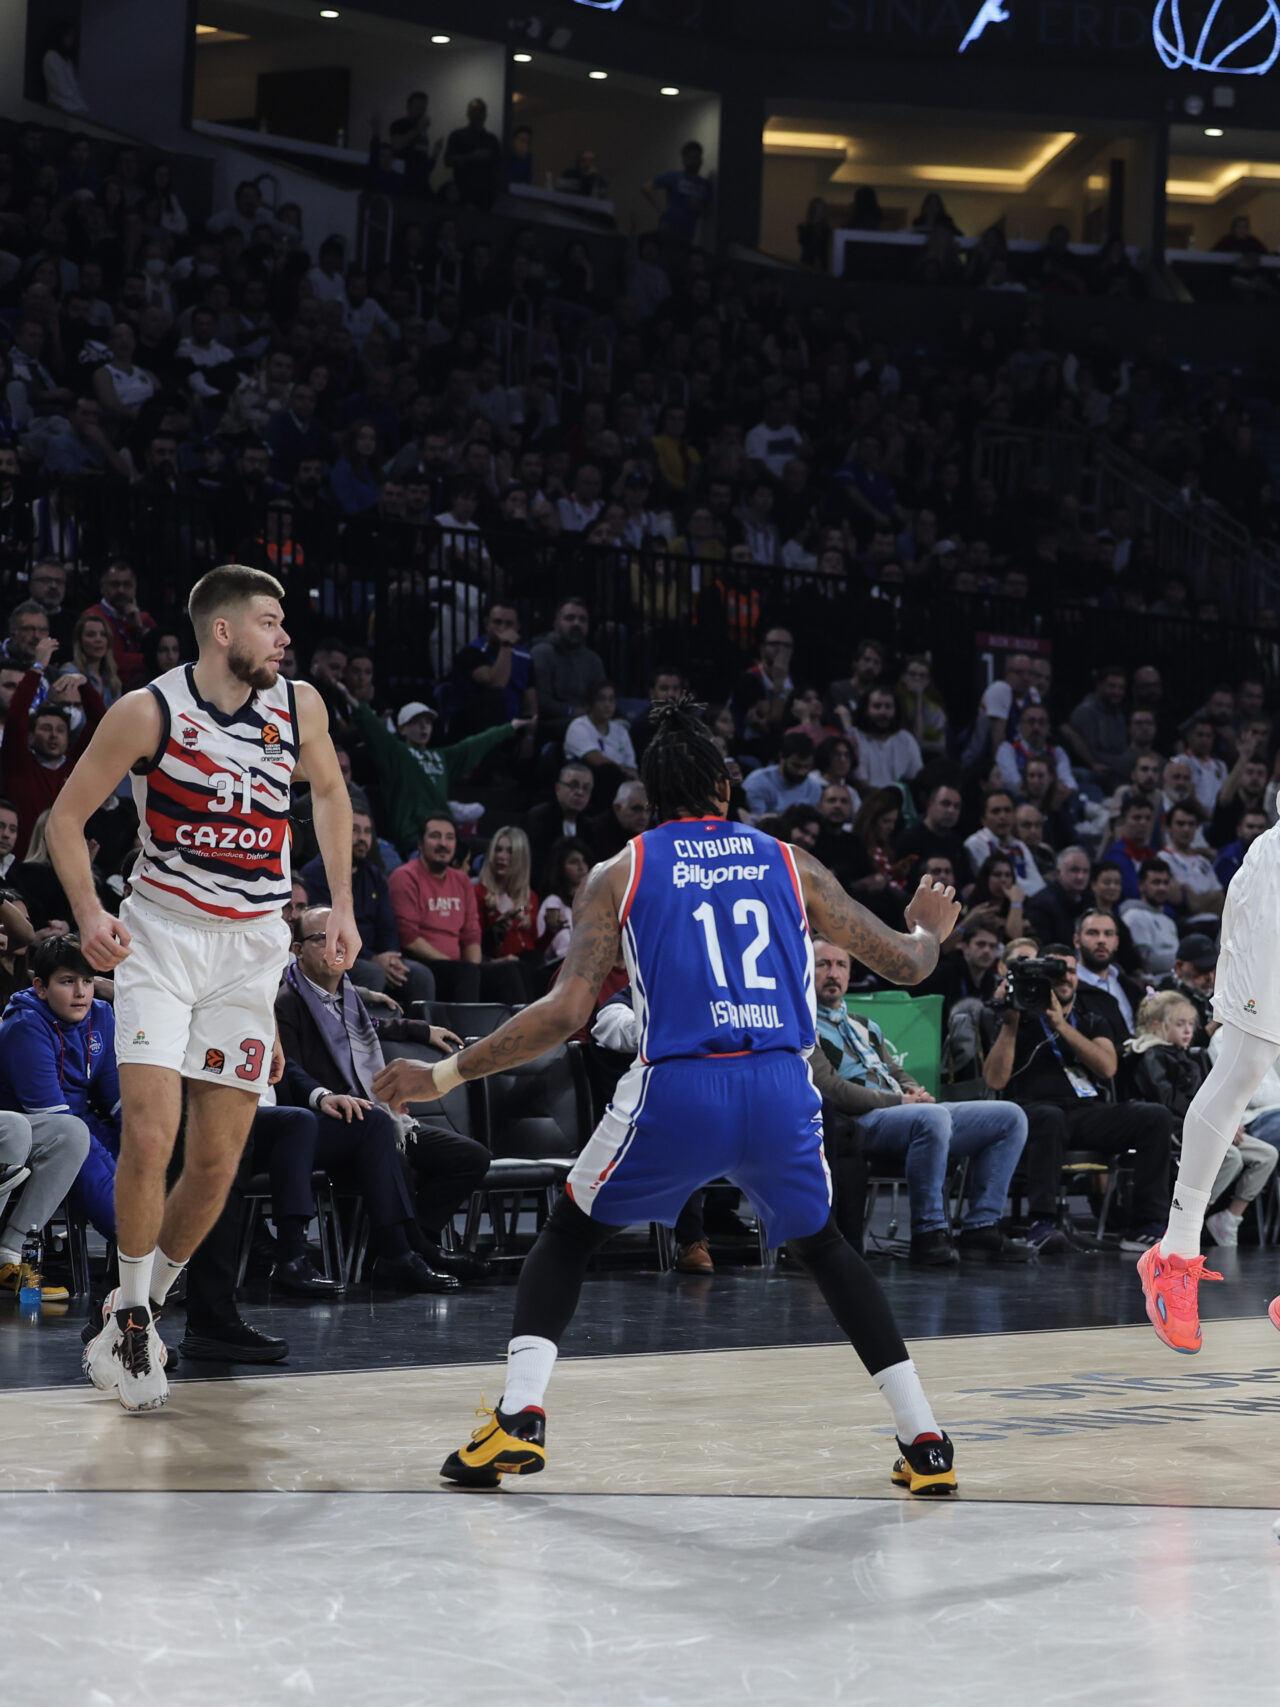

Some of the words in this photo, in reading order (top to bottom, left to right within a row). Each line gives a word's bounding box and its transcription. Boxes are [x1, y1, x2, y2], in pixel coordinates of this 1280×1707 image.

[207, 771, 252, 814] 31
[175, 824, 272, 849] CAZOO
[673, 837, 755, 859] CLYBURN
[672, 861, 770, 890] Bilyoner
[692, 898, 777, 990] 12
[235, 1038, 266, 1082] 3
